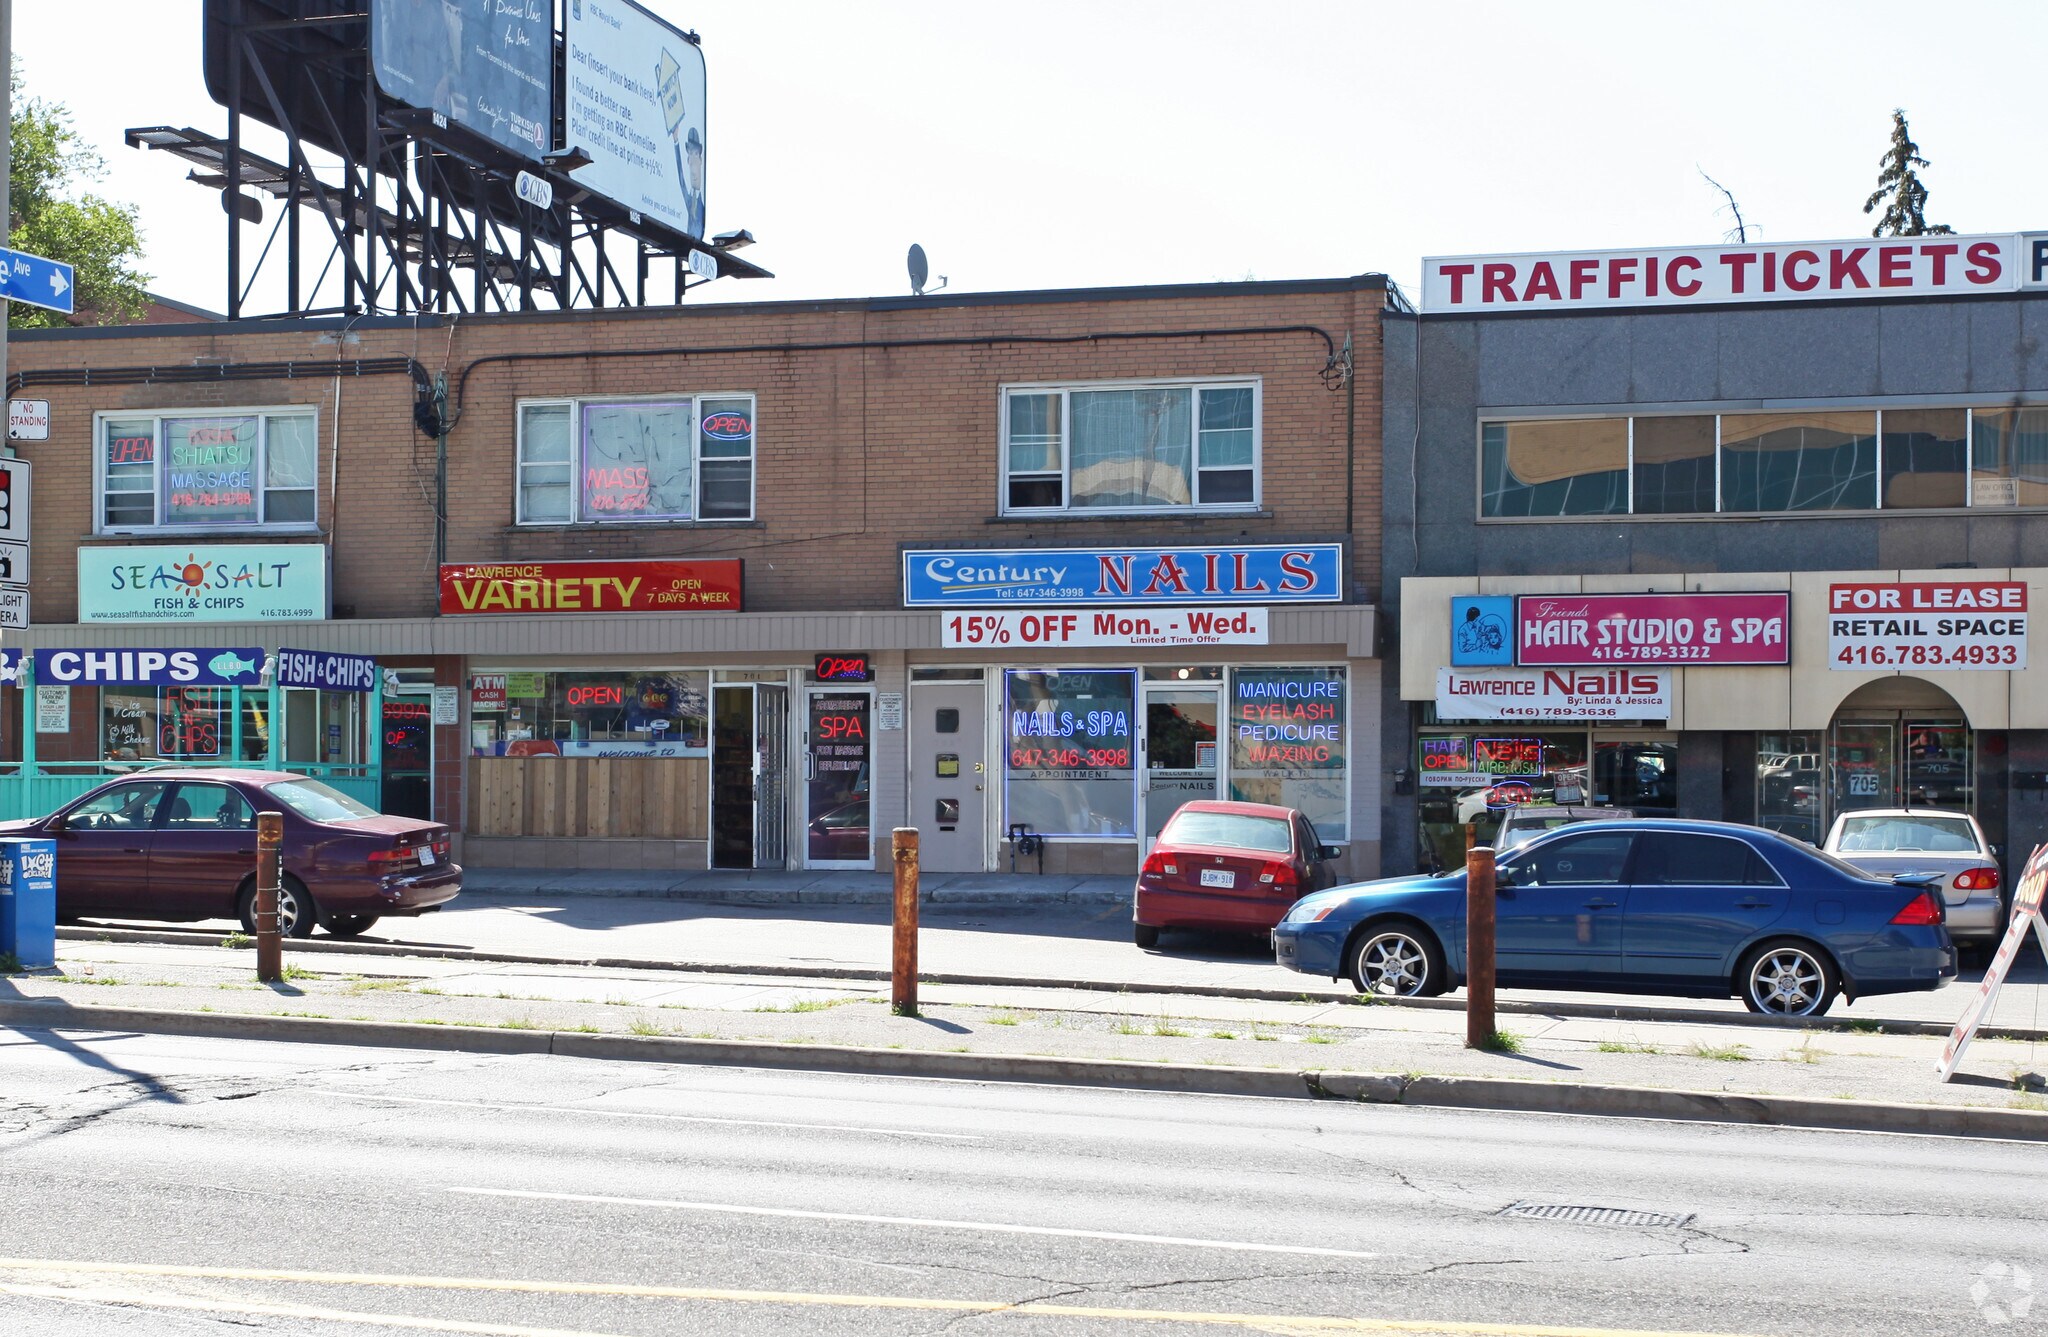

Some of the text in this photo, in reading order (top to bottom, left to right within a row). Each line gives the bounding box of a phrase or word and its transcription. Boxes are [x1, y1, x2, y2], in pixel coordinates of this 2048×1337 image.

[572, 43, 587, 64] Dear
[588, 53, 609, 78] (insert
[609, 66, 623, 87] your
[624, 74, 639, 96] bank
[576, 76, 594, 100] found
[595, 91, 599, 103] a
[600, 89, 619, 113] better
[620, 102, 632, 122] rate.
[510, 111, 534, 131] TURKISH
[571, 96, 657, 155] I'm getting an RBC Homeline
[510, 122, 534, 143] AIRLINES
[588, 128, 606, 149] credit
[606, 136, 619, 155] line
[619, 145, 627, 158] at
[626, 150, 645, 169] prime
[529, 180, 549, 205] CBS
[14, 258, 31, 276] Ave
[700, 255, 715, 278] CBS
[1439, 242, 2002, 304] TRAFFIC TICKETS
[23, 403, 34, 414] NO
[10, 415, 47, 427] STANDING
[704, 416, 751, 433] OPEN
[112, 437, 154, 463] OPEN
[172, 446, 251, 467] SHIATSU
[171, 471, 252, 489] MASSAGE
[587, 467, 649, 490] MASS
[111, 561, 291, 590] SEA SALT
[466, 566, 543, 579] LAWRENCE
[925, 551, 1319, 597] Century NAILS
[453, 576, 643, 611] VARIETY
[671, 580, 702, 590] OPEN
[995, 587, 1085, 599] Tel: 647-346-3998
[154, 597, 245, 609] FISH & CHIPS
[647, 592, 730, 604] 7 DAYS A WEEK
[1833, 587, 2022, 609] FOR LEASE
[90, 610, 195, 619] www.seasaltfishandchips.com
[260, 608, 313, 618] 416.783.4999
[1535, 601, 1590, 618] Friends
[949, 615, 1010, 644] 15%
[1019, 614, 1078, 643] OFF
[1093, 613, 1160, 637] Mon.
[1186, 611, 1257, 635] Wed.
[1524, 616, 1783, 649] HAIR STUDIO & SPA
[1832, 618, 2025, 636] RETAIL SPACE
[1130, 635, 1221, 644] Limited Time Offer
[1591, 645, 1711, 660] 416-789-3322
[1837, 645, 2018, 665] 416.783.4933
[50, 651, 200, 682] CHIPS
[278, 652, 374, 688] FISH & CHIPS
[816, 657, 865, 679] Open
[473, 676, 505, 690] ATM
[1046, 675, 1092, 691] OPEN
[1239, 681, 1339, 699] MANICURE
[1448, 669, 1659, 696] Lawrence Nails
[165, 686, 213, 716] FISH
[473, 700, 506, 708] MACHINE
[479, 691, 499, 699] CASH
[567, 686, 623, 705] OPEN
[1567, 695, 1664, 707] By: Linda & Jessica
[121, 708, 147, 718] Cream
[128, 700, 141, 709] Ice
[382, 701, 430, 719] 699A
[815, 700, 865, 711] AROMATHERAPY
[1242, 703, 1335, 721] EYELASH
[1499, 706, 1541, 718] (416)
[1543, 707, 1617, 717] 789-3636
[120, 724, 136, 734] Milk
[819, 716, 864, 739] SPA
[1012, 710, 1129, 738] NAILS & SPA
[1239, 724, 1339, 742] PEDICURE
[160, 725, 218, 753] CHIPS
[1424, 740, 1465, 753] HAIR
[661, 748, 675, 756] to
[816, 745, 864, 756] FOOT MASSAGE
[1011, 749, 1128, 768] 647-346-3998
[1249, 745, 1329, 763] WAXING
[1476, 741, 1540, 761] Nails
[818, 760, 862, 771] REFLEXOLOGY
[1424, 754, 1467, 769] OPEN
[1927, 763, 1950, 774] 705
[1030, 770, 1110, 779] APPOINTMENT
[1557, 774, 1576, 782] OPEN
[1179, 782, 1215, 790] NAILS
[1851, 776, 1878, 793] 705
[1481, 786, 1533, 804] OPEN
[1221, 874, 1234, 884] 918
